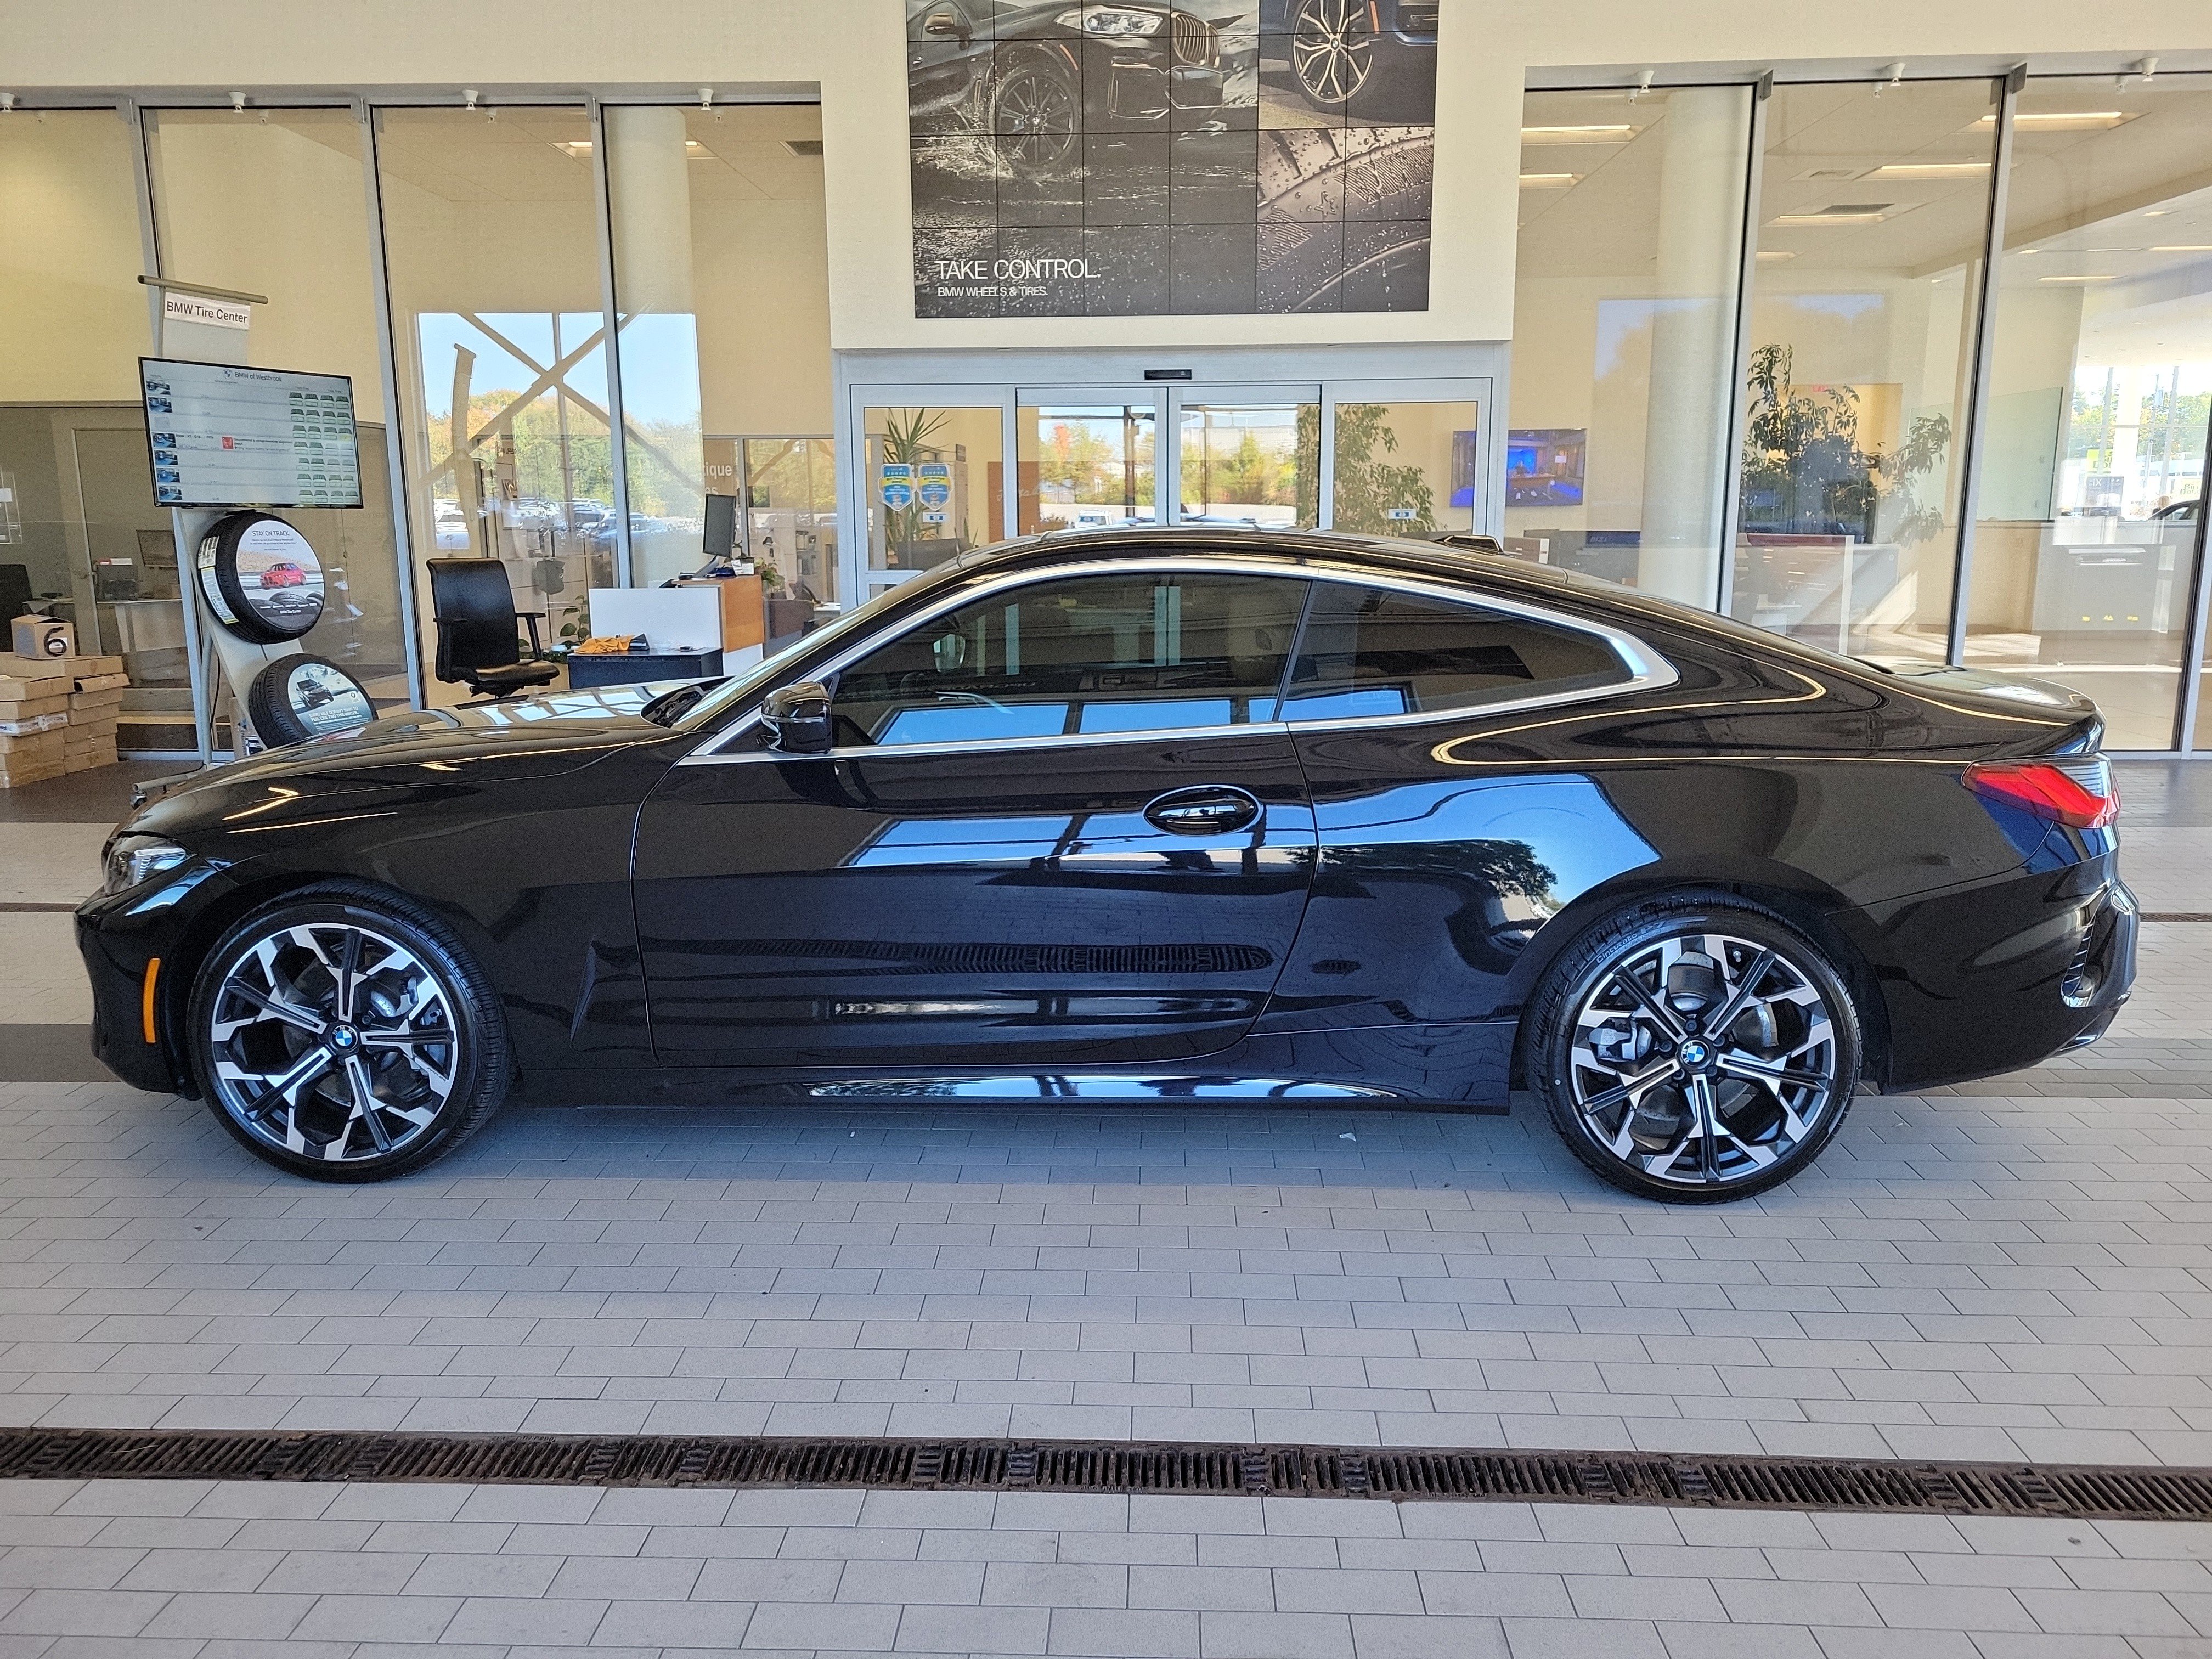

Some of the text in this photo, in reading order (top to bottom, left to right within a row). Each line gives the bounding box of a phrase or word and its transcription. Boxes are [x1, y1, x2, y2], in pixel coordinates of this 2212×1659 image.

[934, 258, 1101, 279] TAKE CONTROL.
[938, 286, 1048, 297] BMW WHEELS & TIRES.
[167, 301, 247, 323] BMW Tire Center
[703, 461, 733, 480] ique
[43, 626, 67, 657] 6
[1596, 932, 1638, 964] Cinturato
